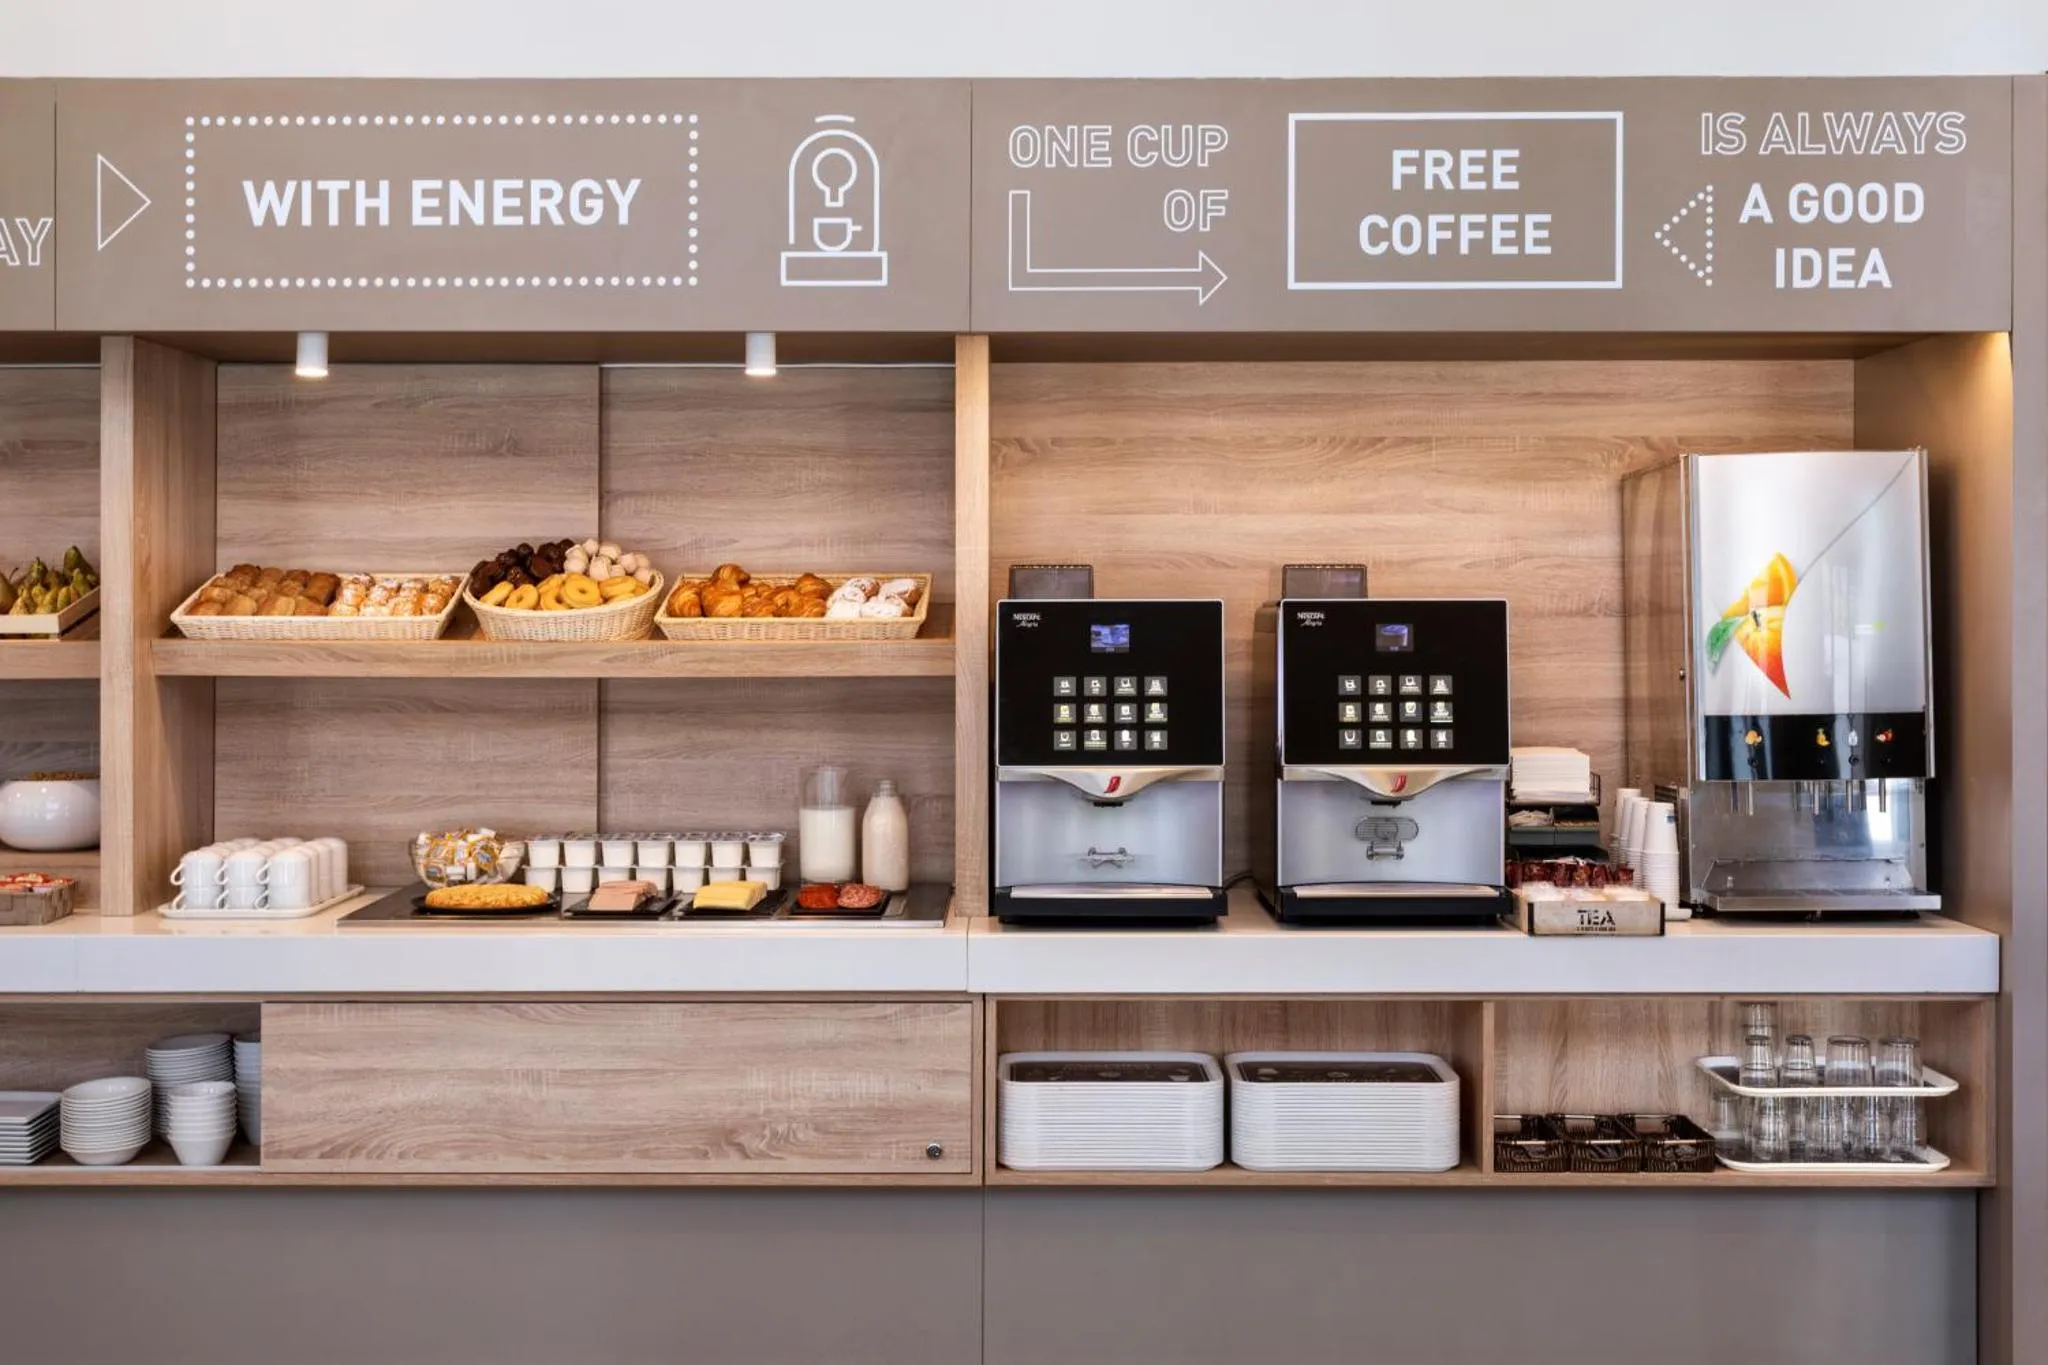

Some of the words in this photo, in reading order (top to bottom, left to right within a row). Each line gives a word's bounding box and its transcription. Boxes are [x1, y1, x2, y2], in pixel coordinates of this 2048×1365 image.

[1008, 124, 1112, 168] ONE
[1126, 124, 1229, 168] CUP
[1700, 111, 1747, 155] IS
[1758, 111, 1968, 156] ALWAYS
[1391, 149, 1521, 191] FREE
[241, 179, 390, 227] WITH
[411, 178, 642, 227] ENERGY
[1163, 188, 1229, 232] OF
[1738, 182, 1774, 224] A
[1787, 181, 1925, 224] GOOD
[1358, 213, 1553, 255] COFFEE
[1775, 247, 1893, 289] IDEA
[1576, 909, 1616, 926] TEA
